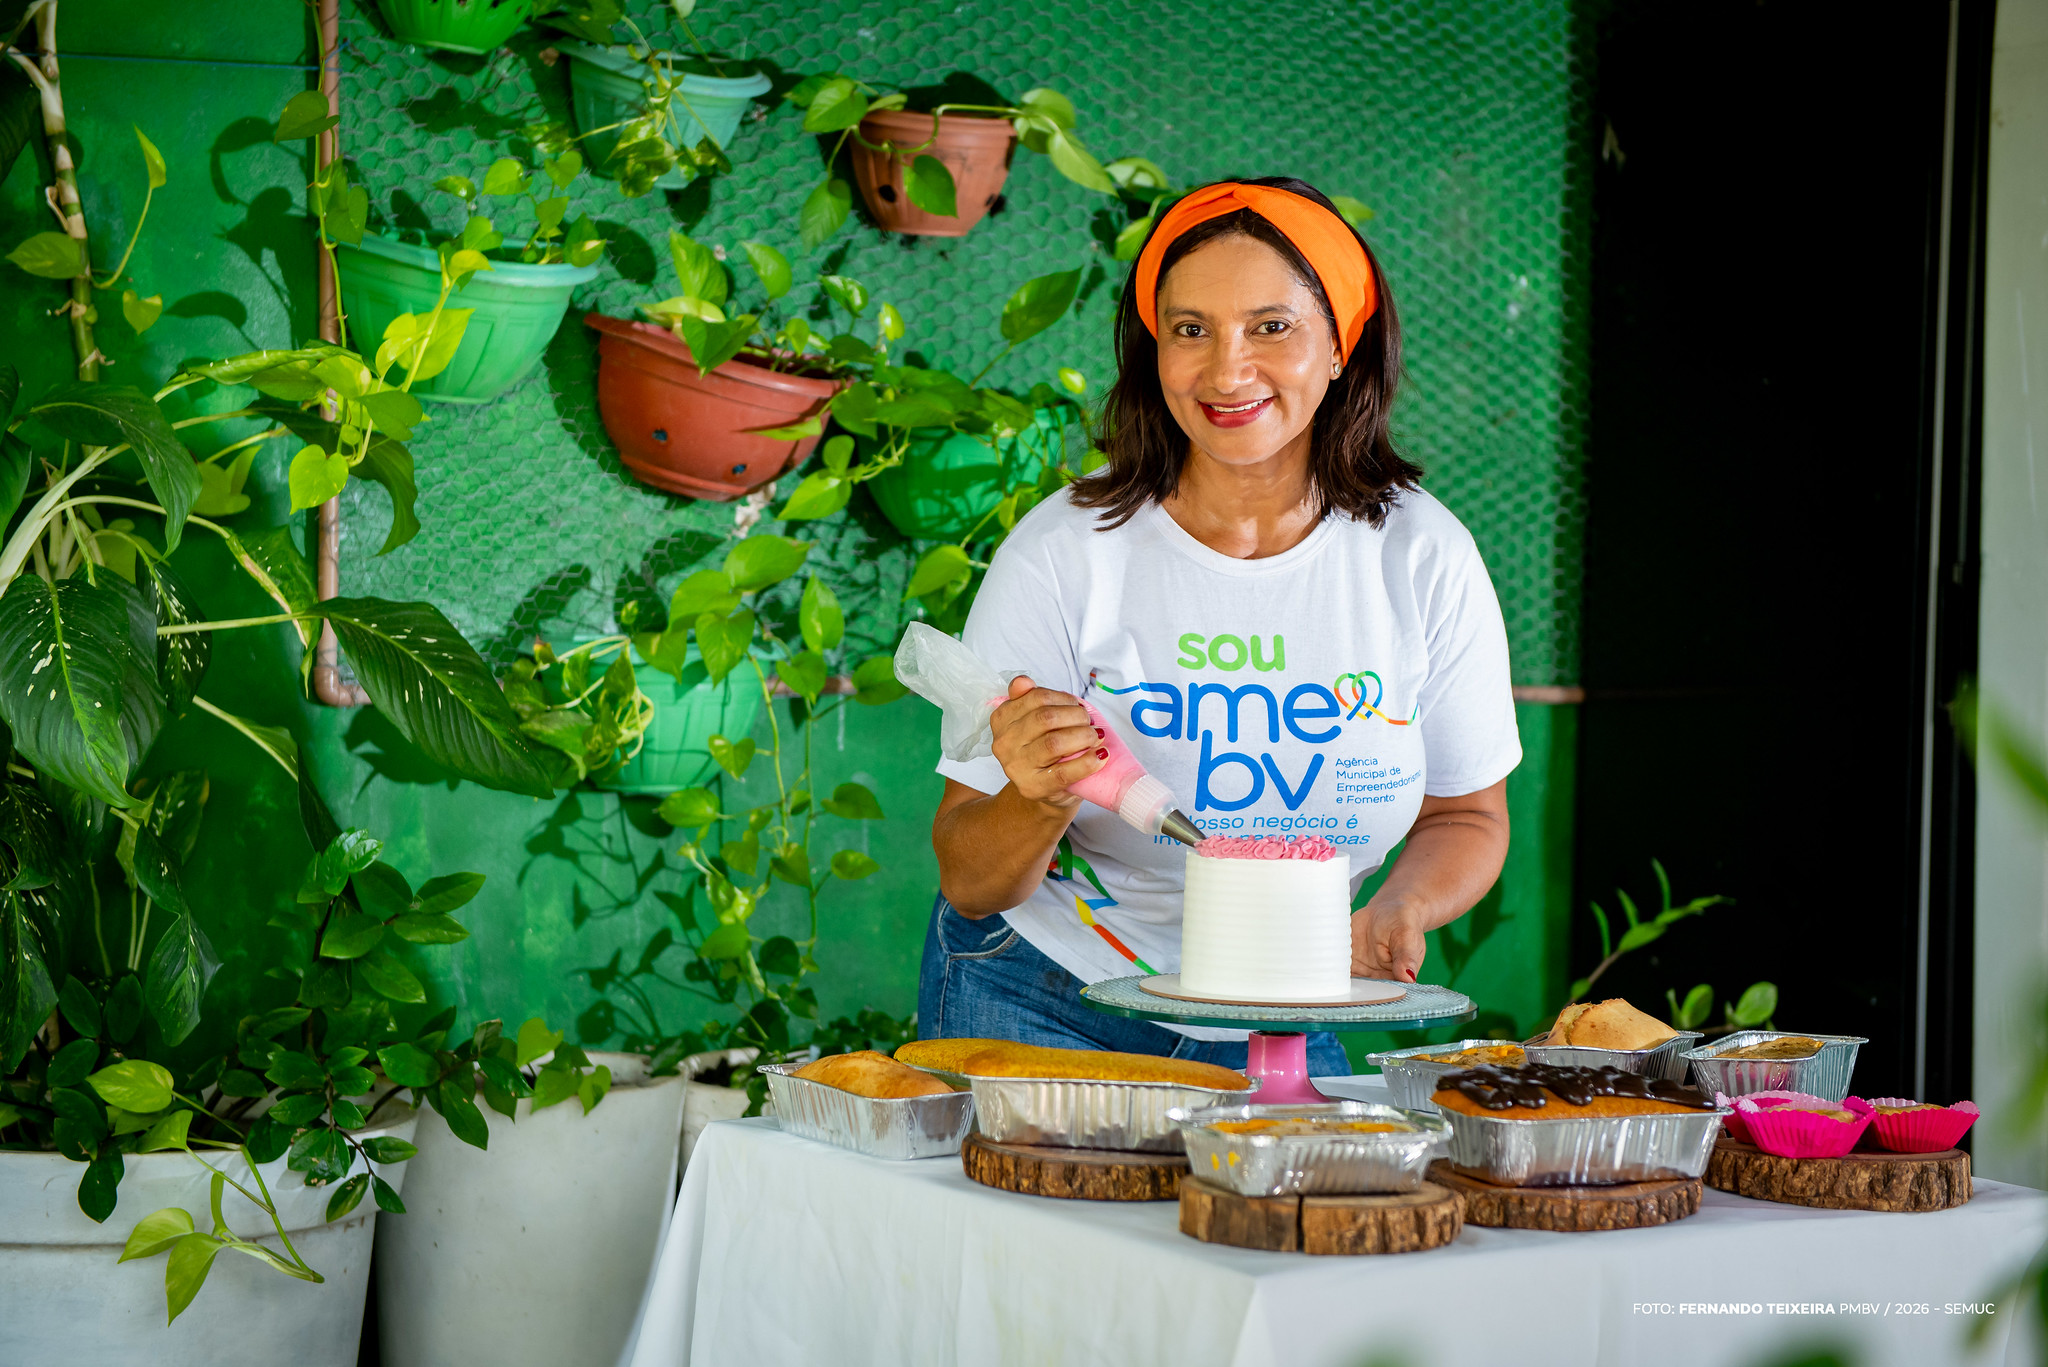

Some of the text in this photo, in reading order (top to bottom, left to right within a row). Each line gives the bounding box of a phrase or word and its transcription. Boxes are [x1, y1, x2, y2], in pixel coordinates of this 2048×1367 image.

[1177, 633, 1286, 672] sou
[1131, 681, 1342, 744] ame
[1194, 729, 1325, 812] bv
[1335, 757, 1379, 768] Agência
[1336, 766, 1401, 780] Municipal de
[1336, 794, 1396, 805] e Fomento
[1188, 813, 1359, 832] osso negócio é
